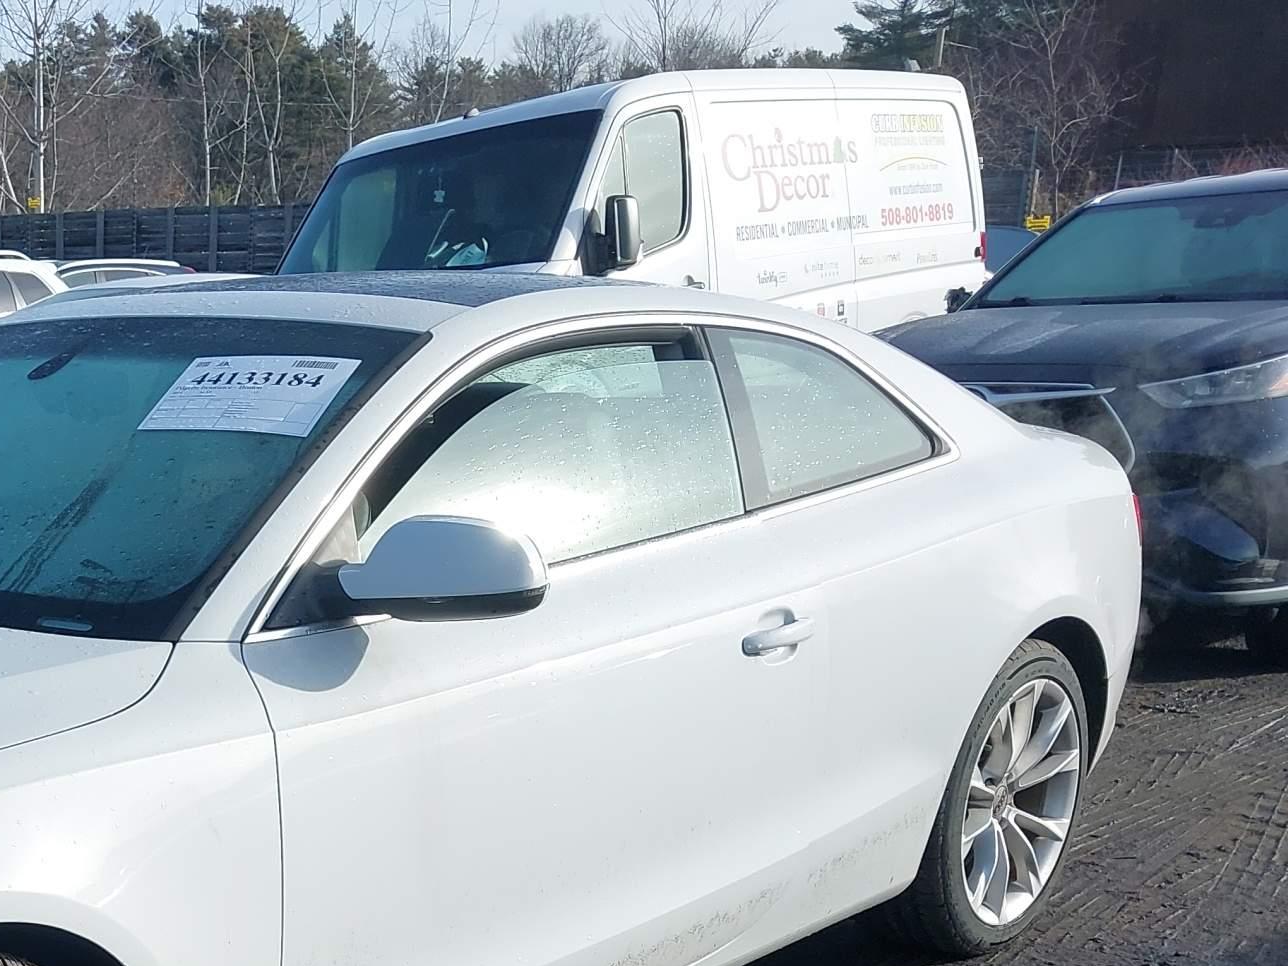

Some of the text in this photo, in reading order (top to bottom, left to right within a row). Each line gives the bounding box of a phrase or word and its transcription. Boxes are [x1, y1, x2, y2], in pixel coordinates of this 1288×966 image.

[753, 170, 830, 213] Decor
[881, 203, 954, 226] 508-801-8819
[735, 215, 870, 241] RESIDENTIAL COMMERCIAL MUNICIPAL
[191, 371, 325, 388] 44133184
